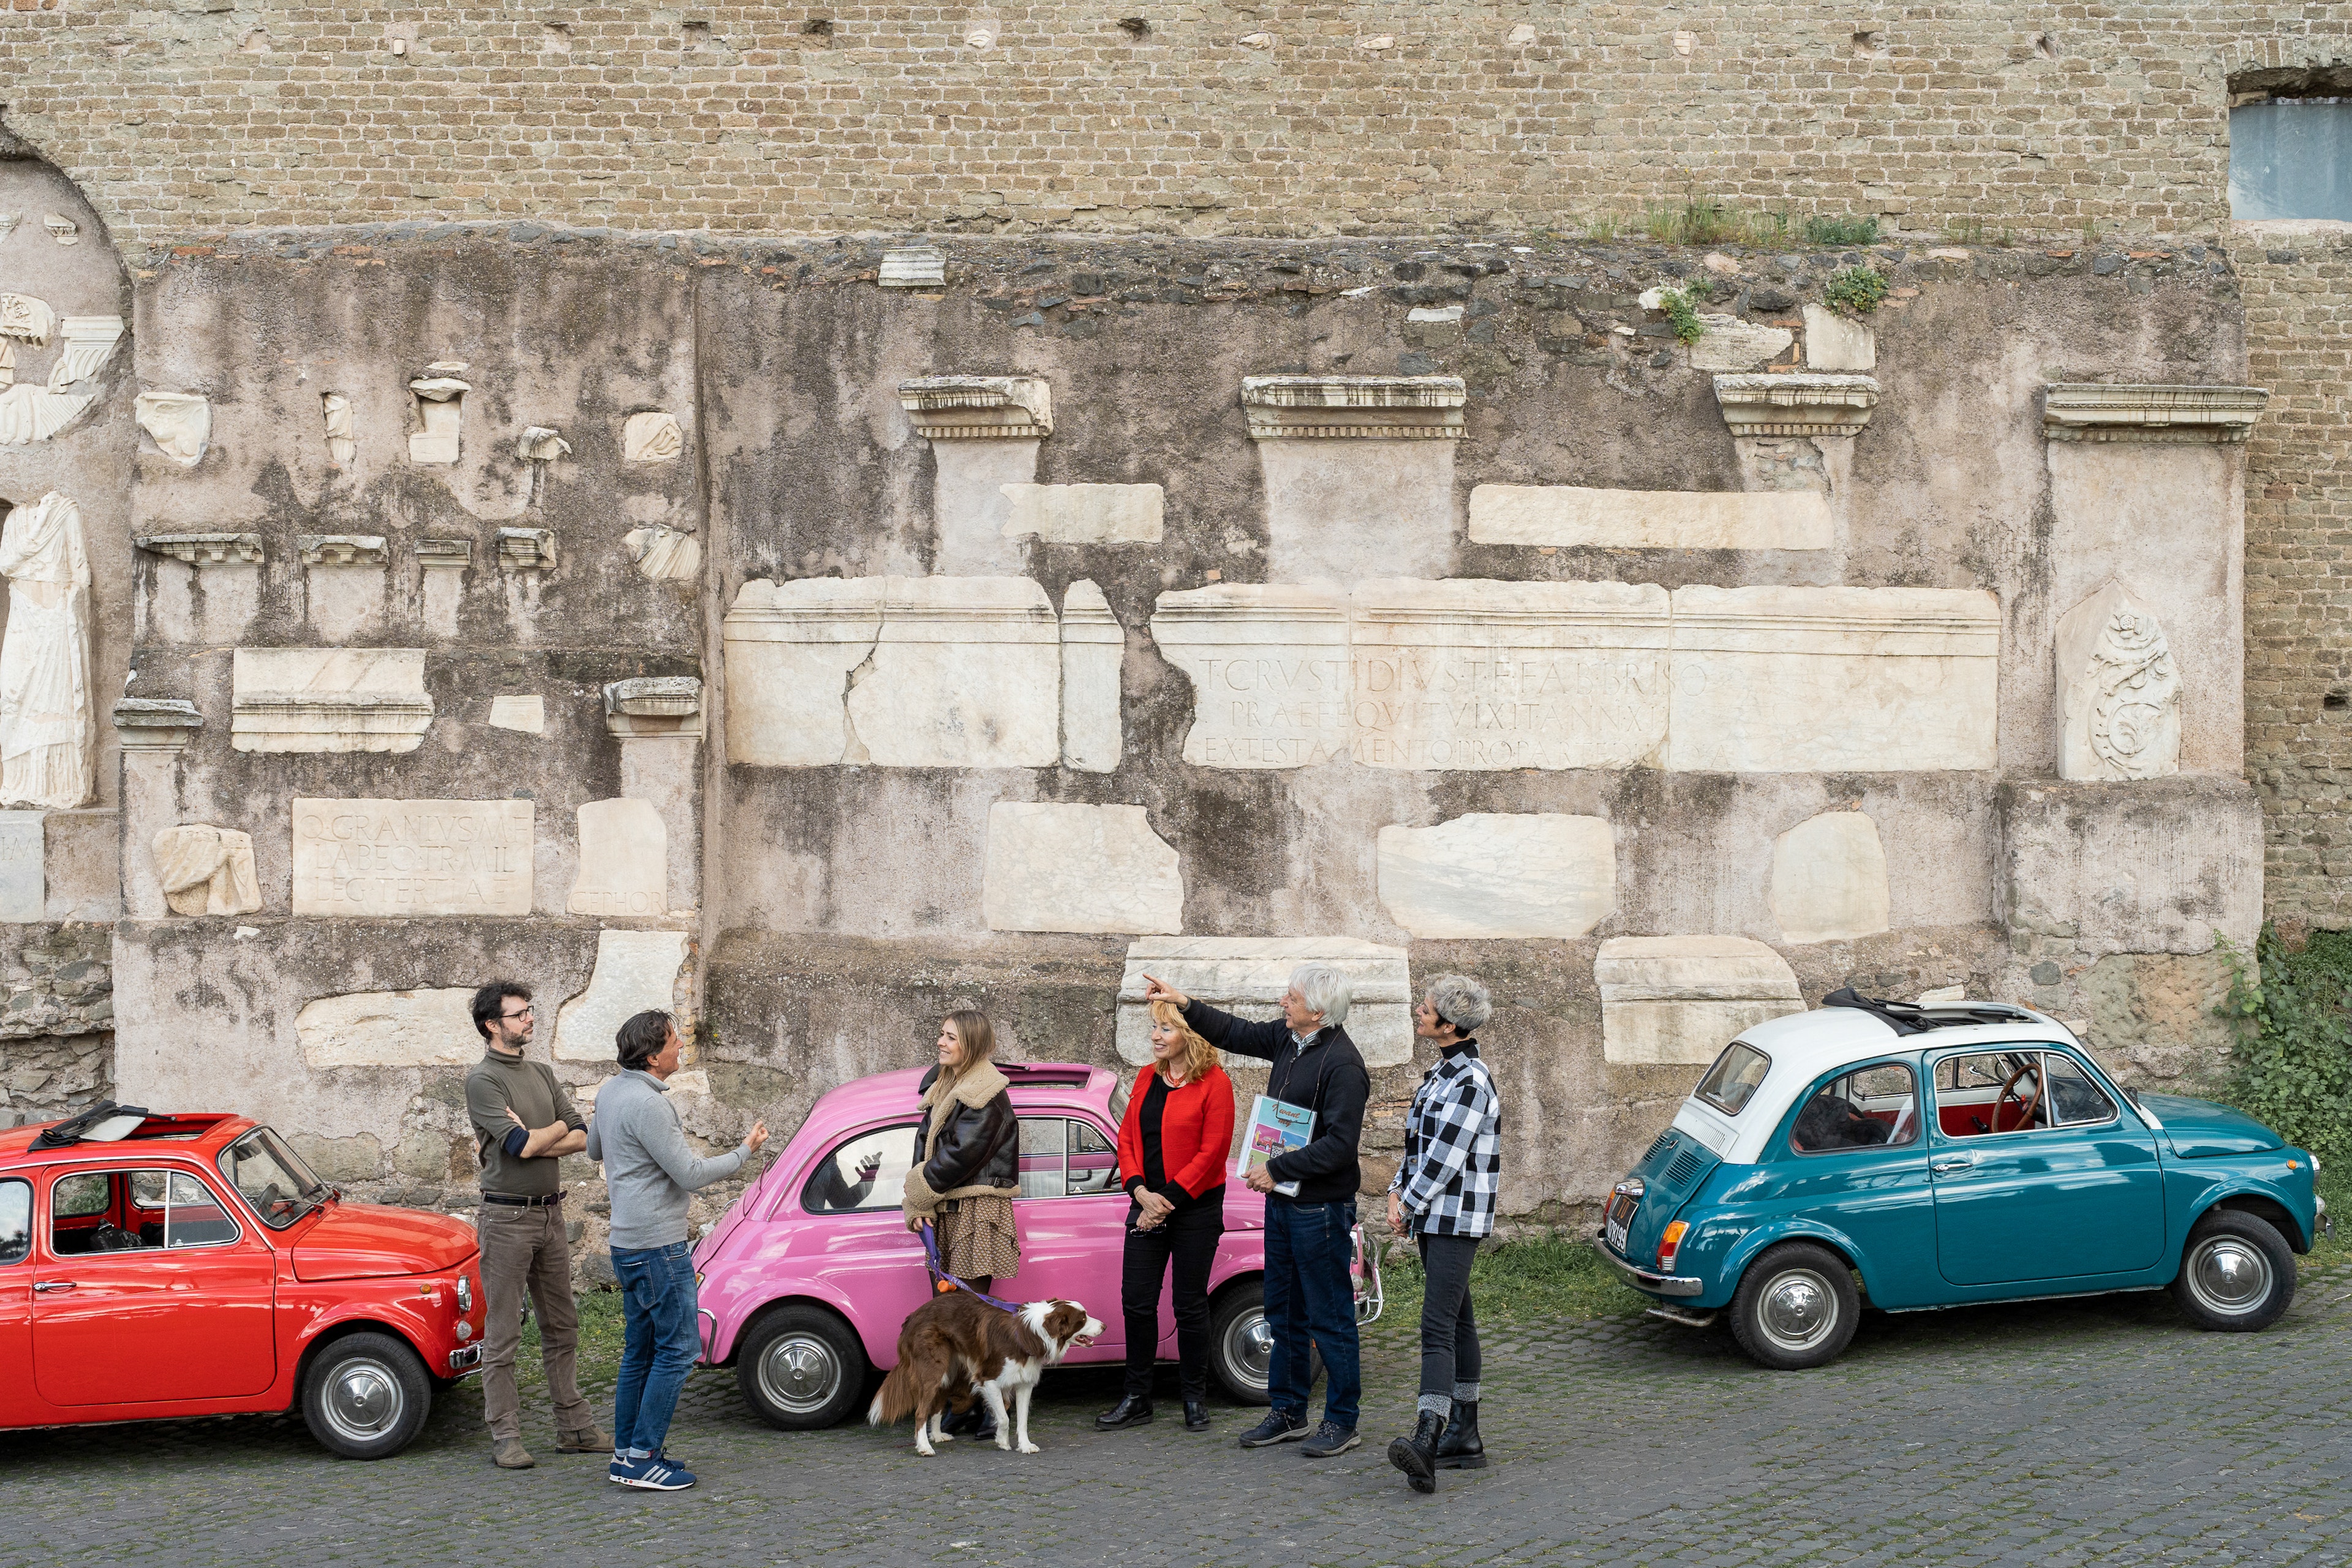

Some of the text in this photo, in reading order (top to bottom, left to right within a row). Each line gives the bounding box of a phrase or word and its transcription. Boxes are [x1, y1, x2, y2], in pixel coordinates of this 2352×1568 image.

[570, 891, 666, 913] CEPHOR
[1280, 1109, 1300, 1118] want
[1617, 1197, 1630, 1219] TO
